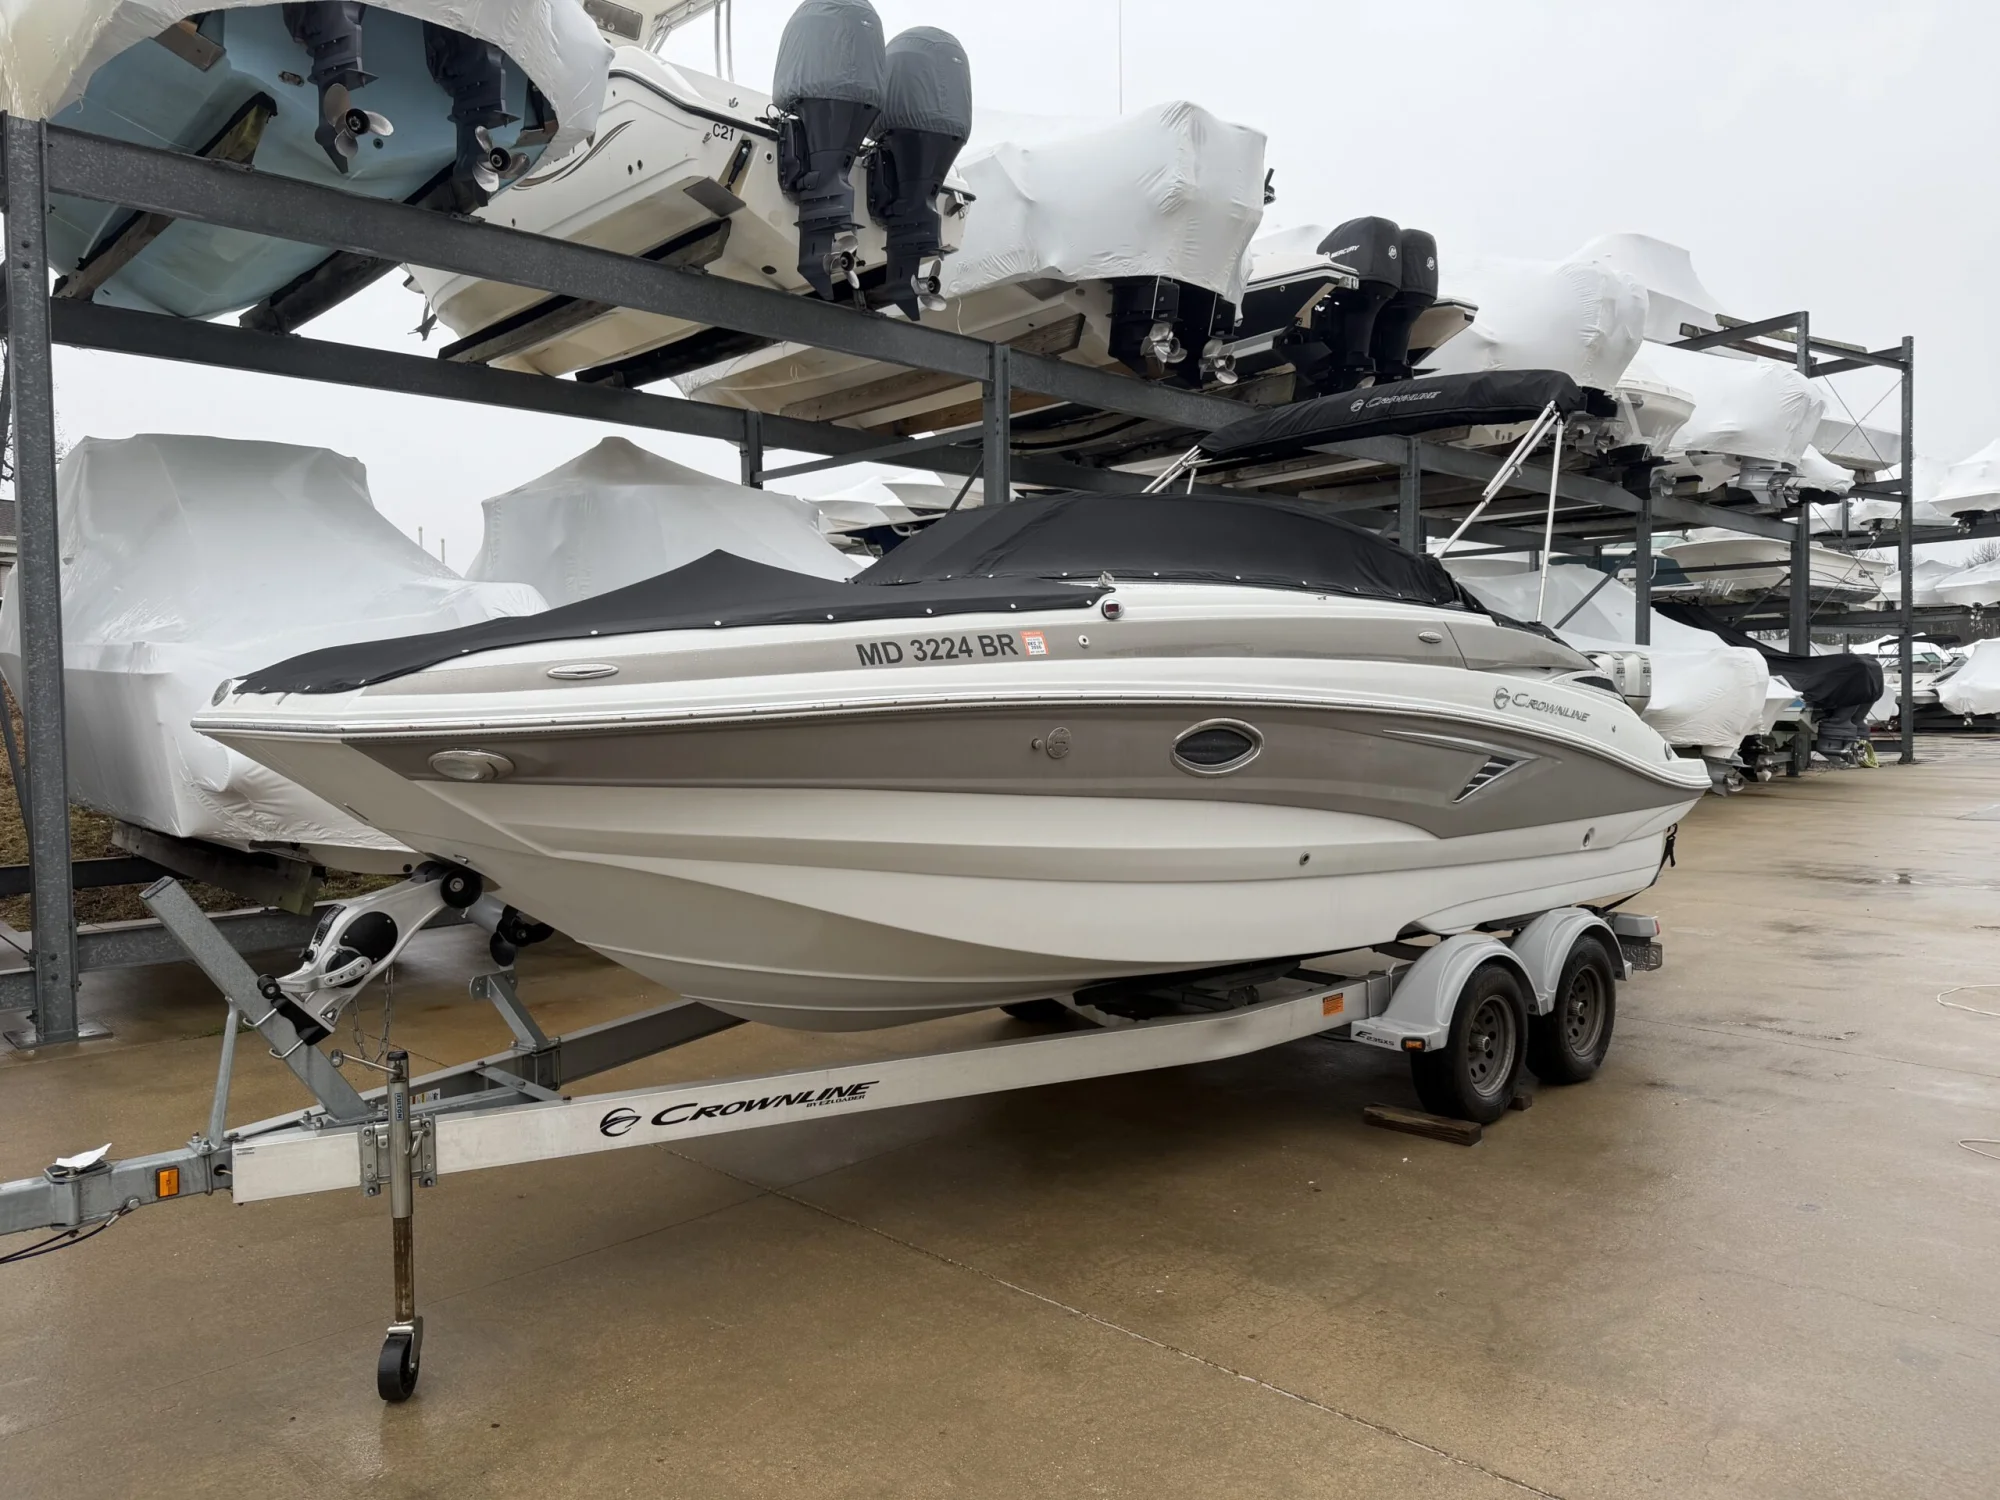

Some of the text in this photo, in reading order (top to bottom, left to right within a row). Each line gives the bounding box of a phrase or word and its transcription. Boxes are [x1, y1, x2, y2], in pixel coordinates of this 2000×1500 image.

[712, 123, 734, 141] C21
[1365, 391, 1441, 408] CROWNLINE
[855, 633, 1018, 666] MD 3224 BR
[1511, 692, 1590, 722] CROWNLINE
[651, 1080, 880, 1126] CROWNLINE
[819, 1094, 866, 1106] EZLOADER
